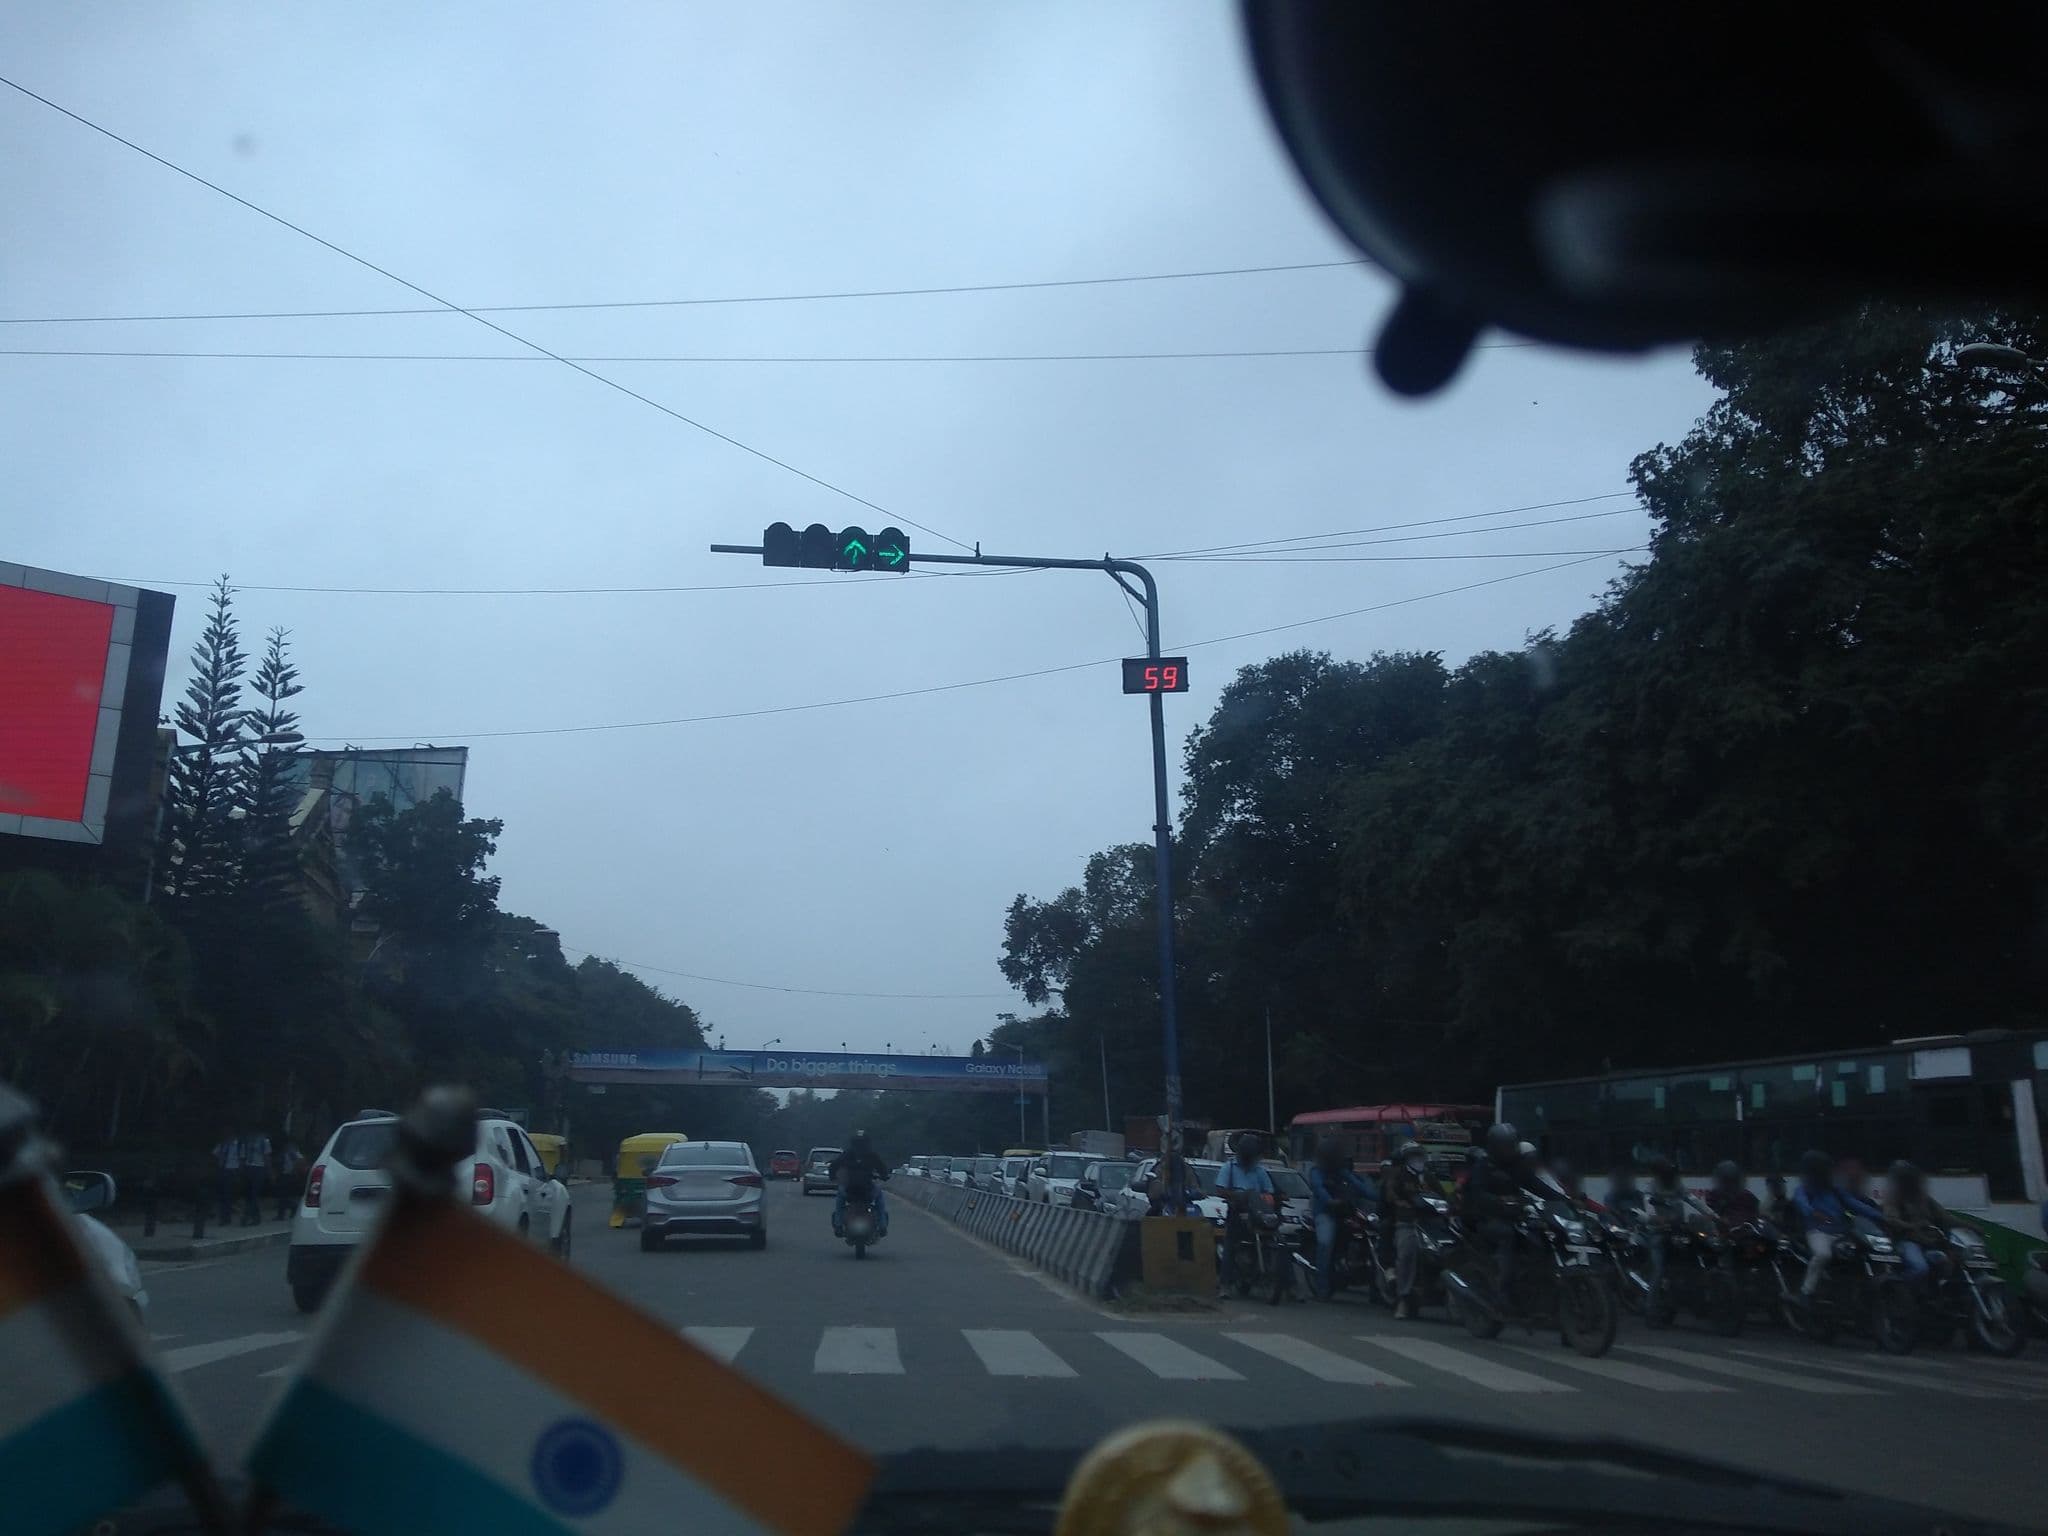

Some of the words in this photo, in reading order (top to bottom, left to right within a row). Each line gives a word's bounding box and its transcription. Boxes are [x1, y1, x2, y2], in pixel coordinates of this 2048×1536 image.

[1144, 667, 1178, 689] 59
[573, 1052, 638, 1064] SAMSUNG
[767, 1058, 788, 1071] Do
[791, 1058, 845, 1076] bigger
[847, 1060, 897, 1077] things
[965, 1063, 1006, 1075] Galaxy
